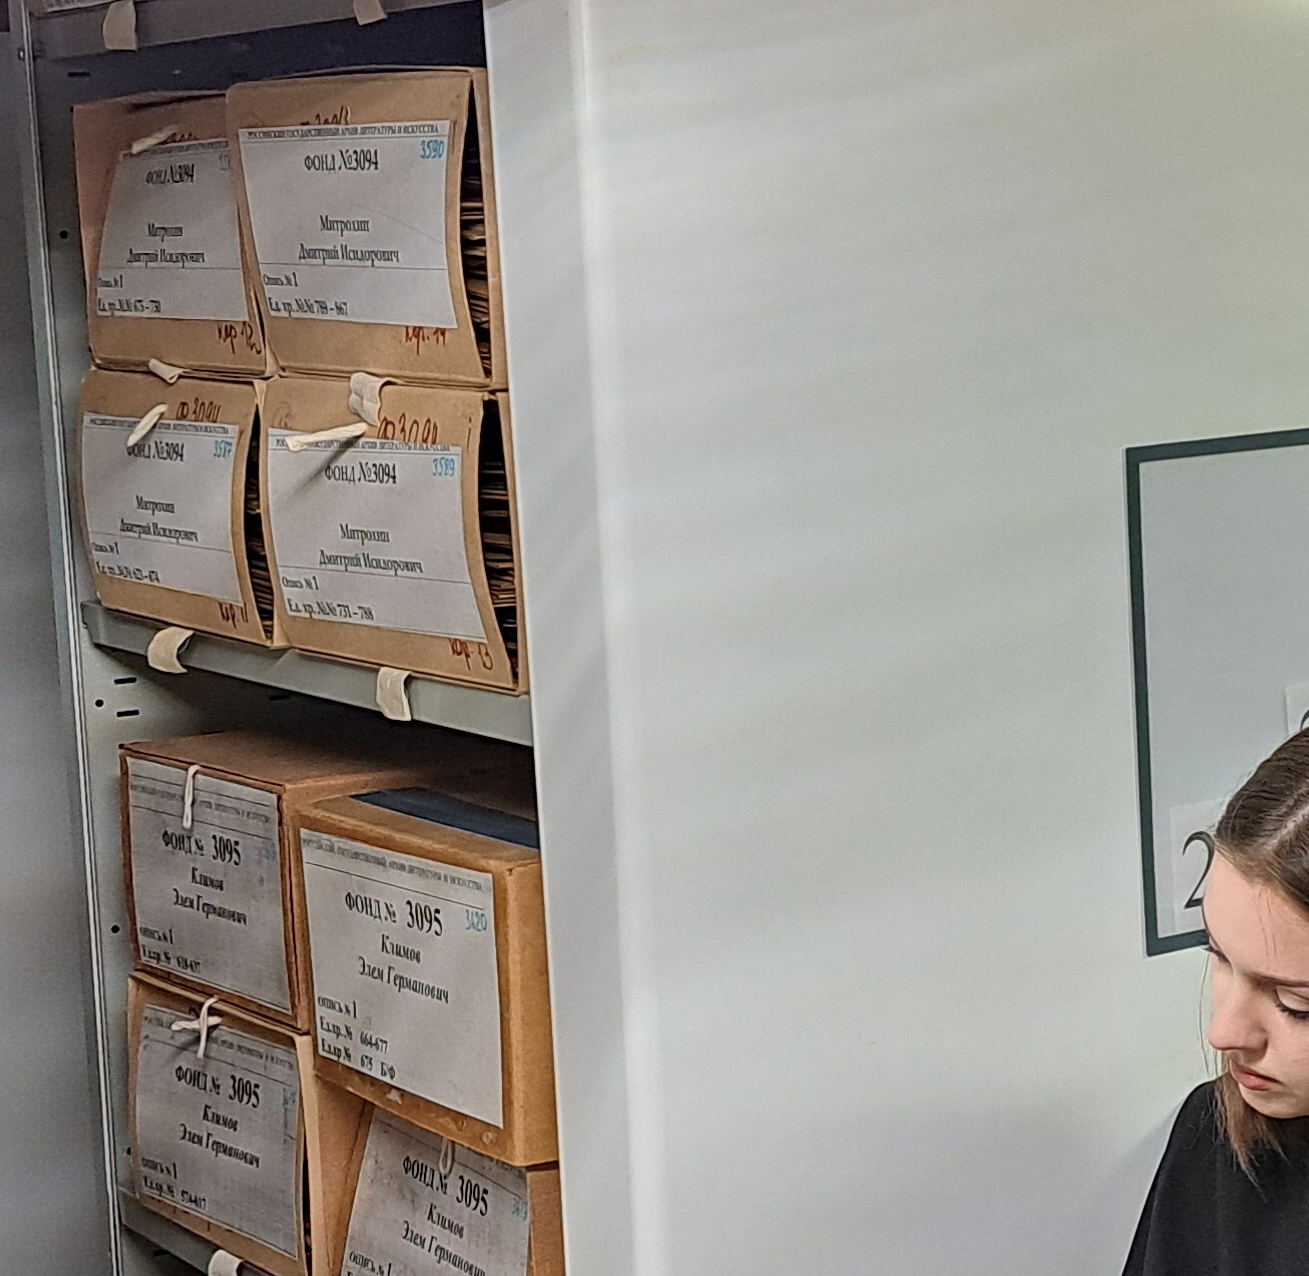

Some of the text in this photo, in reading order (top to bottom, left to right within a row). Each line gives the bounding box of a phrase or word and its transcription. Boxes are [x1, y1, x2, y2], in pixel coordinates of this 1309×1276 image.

[304, 155, 336, 174] ФОНД
[325, 462, 397, 485] ФОНД №3094
[432, 457, 456, 477] 3589
[340, 523, 390, 546] Митрохин
[162, 830, 192, 856] ФОНД
[211, 834, 241, 866] 3095
[345, 891, 383, 925] ФОНД
[405, 899, 443, 937] 3095
[381, 933, 421, 964] Климов
[358, 956, 450, 1004] Элем Германович
[175, 1065, 207, 1093] ФОНД
[229, 1074, 260, 1109] 3095
[403, 1155, 435, 1190] ФОНД
[456, 1175, 489, 1217] 3095
[402, 1220, 425, 1249] Элем
[427, 1203, 465, 1239] Климов
